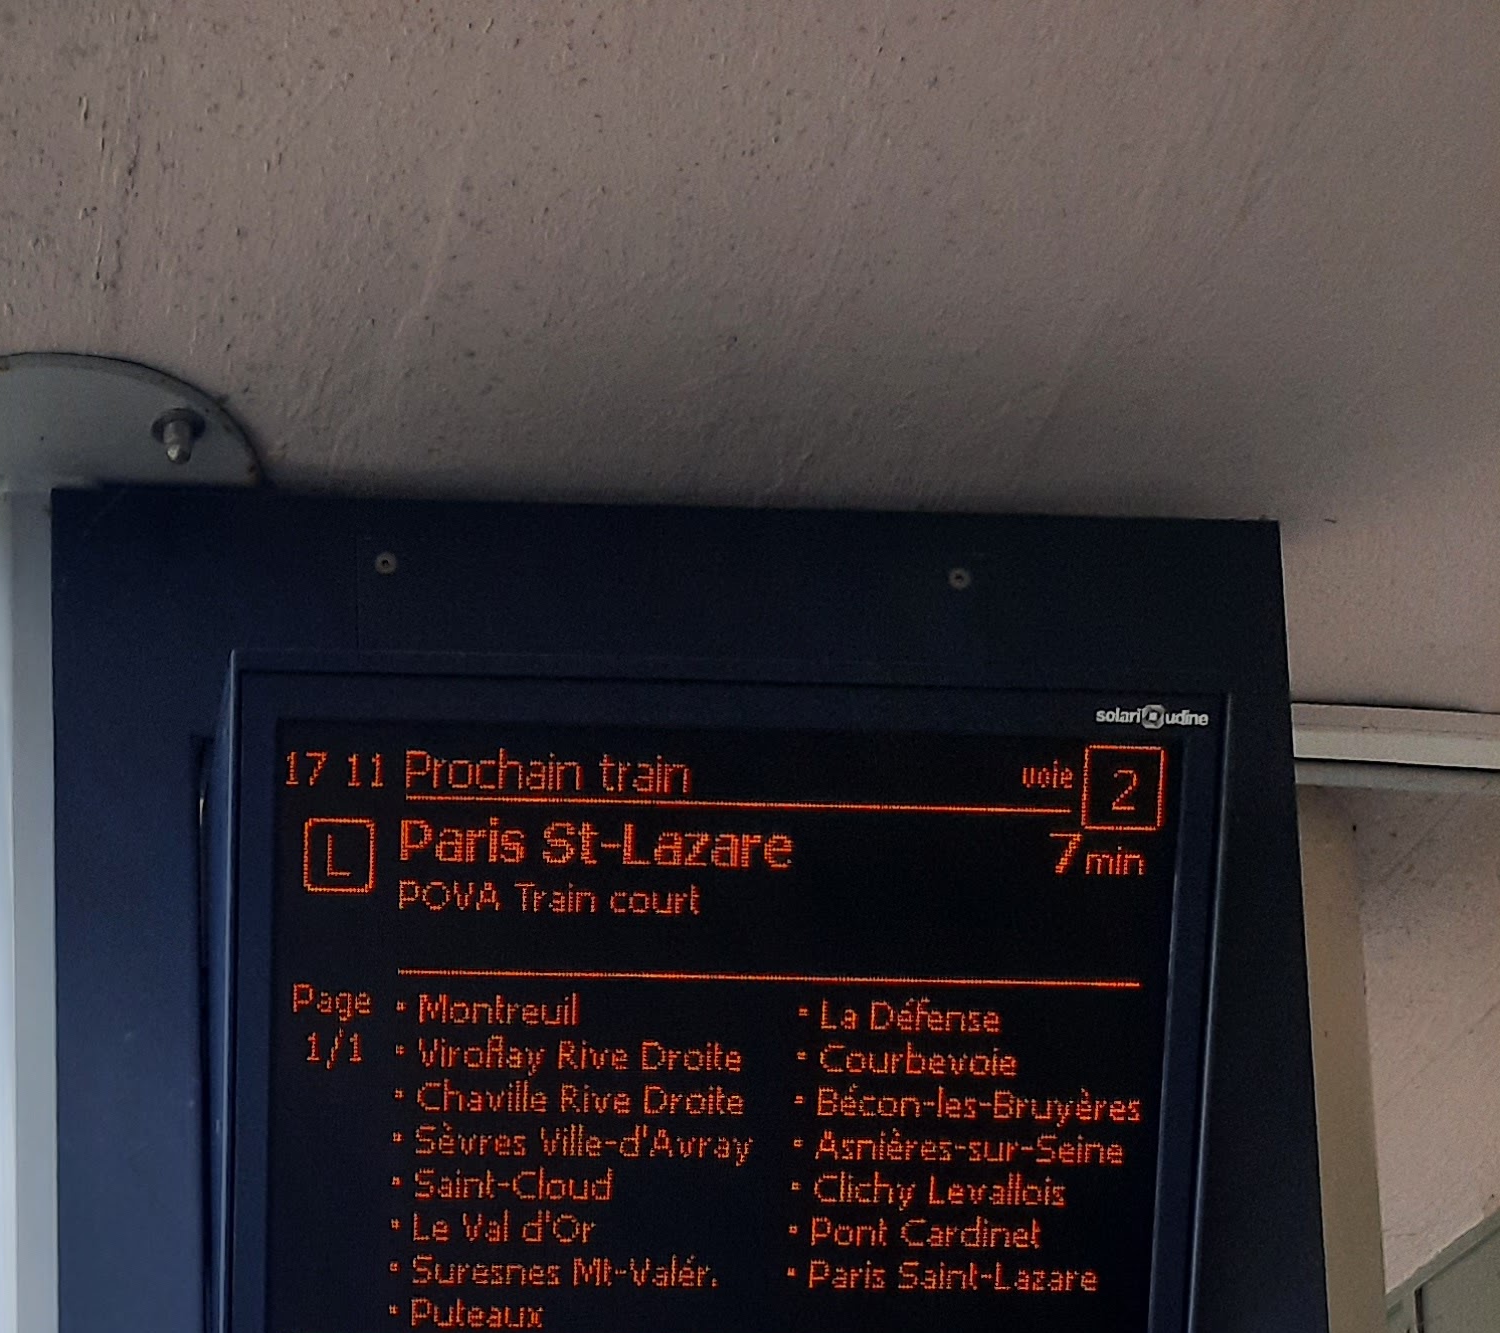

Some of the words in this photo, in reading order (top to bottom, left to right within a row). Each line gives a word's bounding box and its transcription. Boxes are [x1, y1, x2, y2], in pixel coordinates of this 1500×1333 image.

[1095, 706, 1142, 724] solari
[1165, 709, 1209, 726] udine
[285, 751, 329, 787] 17
[347, 752, 385, 788] 11
[404, 747, 583, 791] Prochain
[598, 753, 691, 794] train
[1021, 758, 1075, 790] voie
[1111, 769, 1139, 811] 2
[325, 833, 352, 877] L
[399, 816, 527, 864] Paris
[541, 820, 794, 870] St-Lazare
[1049, 831, 1083, 875] 7
[1085, 845, 1147, 876] min
[398, 879, 500, 912] POVA
[513, 880, 597, 914] Train
[608, 884, 701, 916] court
[292, 983, 372, 1021] Page
[418, 993, 580, 1025] Montreuil
[819, 997, 860, 1031] La
[870, 995, 1002, 1033] Défense
[305, 1028, 363, 1069] 1/1
[418, 1033, 548, 1077] Viroflay
[557, 1038, 629, 1071] Rive
[640, 1040, 743, 1073] Droite
[819, 1041, 1019, 1077] Courbevoie
[416, 1078, 549, 1113] Chaville
[559, 1082, 632, 1115] Rive
[642, 1084, 745, 1116] Droite
[816, 1083, 1142, 1128] Bécon-les-Bruyères
[414, 1120, 527, 1157] Sèvres
[540, 1123, 755, 1167] Ville-d'Avray
[814, 1128, 1125, 1164] Asnières-sur-Seine
[414, 1166, 615, 1201] Saint-Cloud
[813, 1170, 917, 1212] Clichy
[927, 1172, 1067, 1207] Levallois
[412, 1211, 450, 1244] Le
[462, 1209, 510, 1244] Val
[521, 1209, 597, 1244] d'Or
[810, 1215, 888, 1247] Pont
[900, 1215, 1043, 1250] Cardinet
[411, 1253, 562, 1286] Suresnes
[572, 1253, 720, 1288] Mt-Valér.
[808, 1258, 887, 1289] Paris
[897, 1260, 1100, 1292] Saint-Lazare
[410, 1297, 545, 1329] Puteaux
